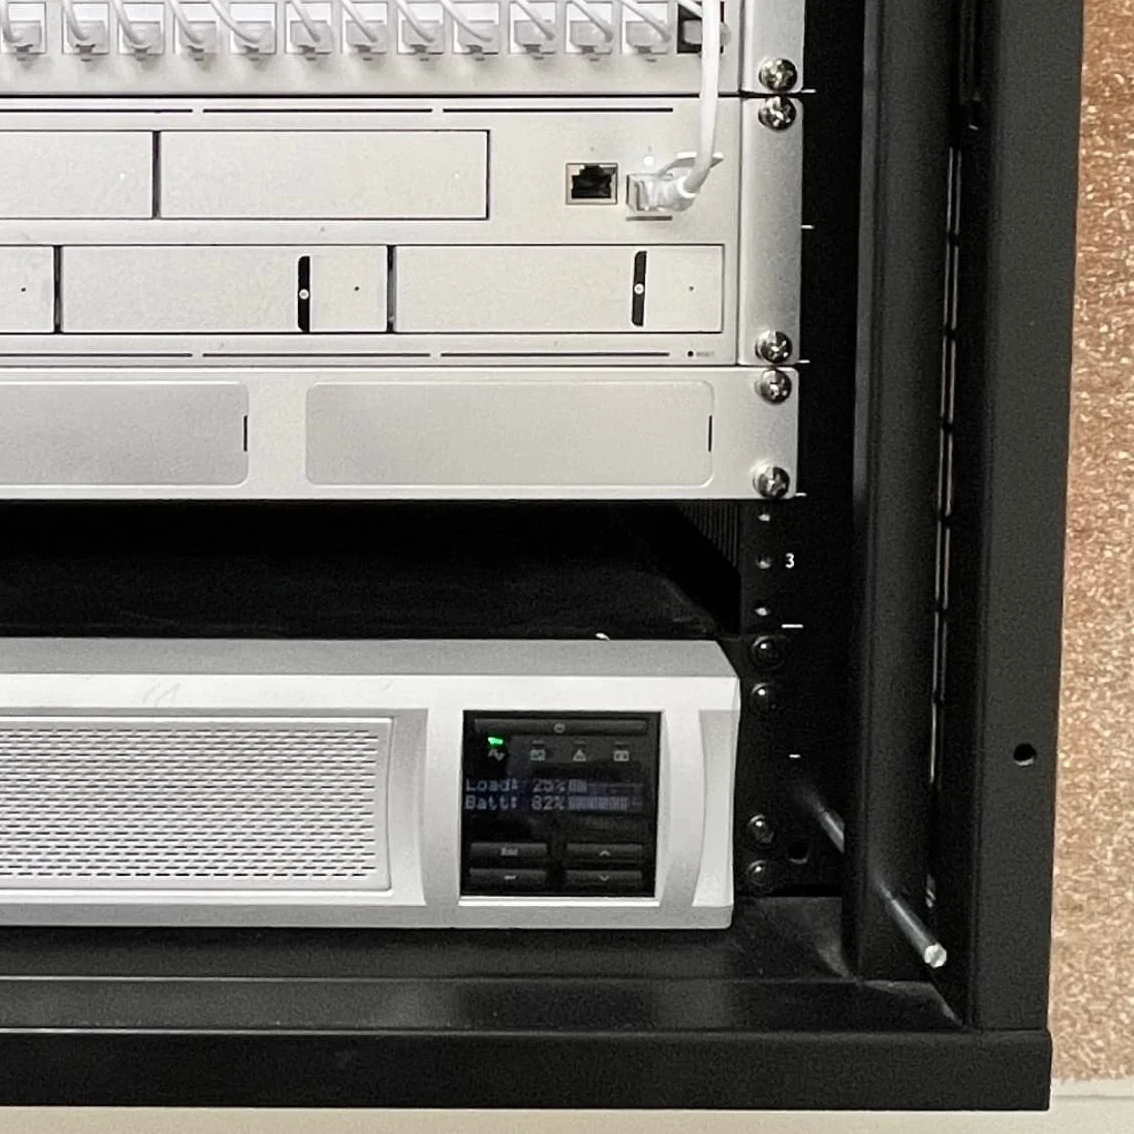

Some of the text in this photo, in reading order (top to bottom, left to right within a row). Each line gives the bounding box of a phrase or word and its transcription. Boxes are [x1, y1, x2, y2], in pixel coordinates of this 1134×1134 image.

[784, 552, 795, 569] 3
[465, 777, 567, 792] Load: 25%
[464, 794, 565, 811] Batt: 82%
